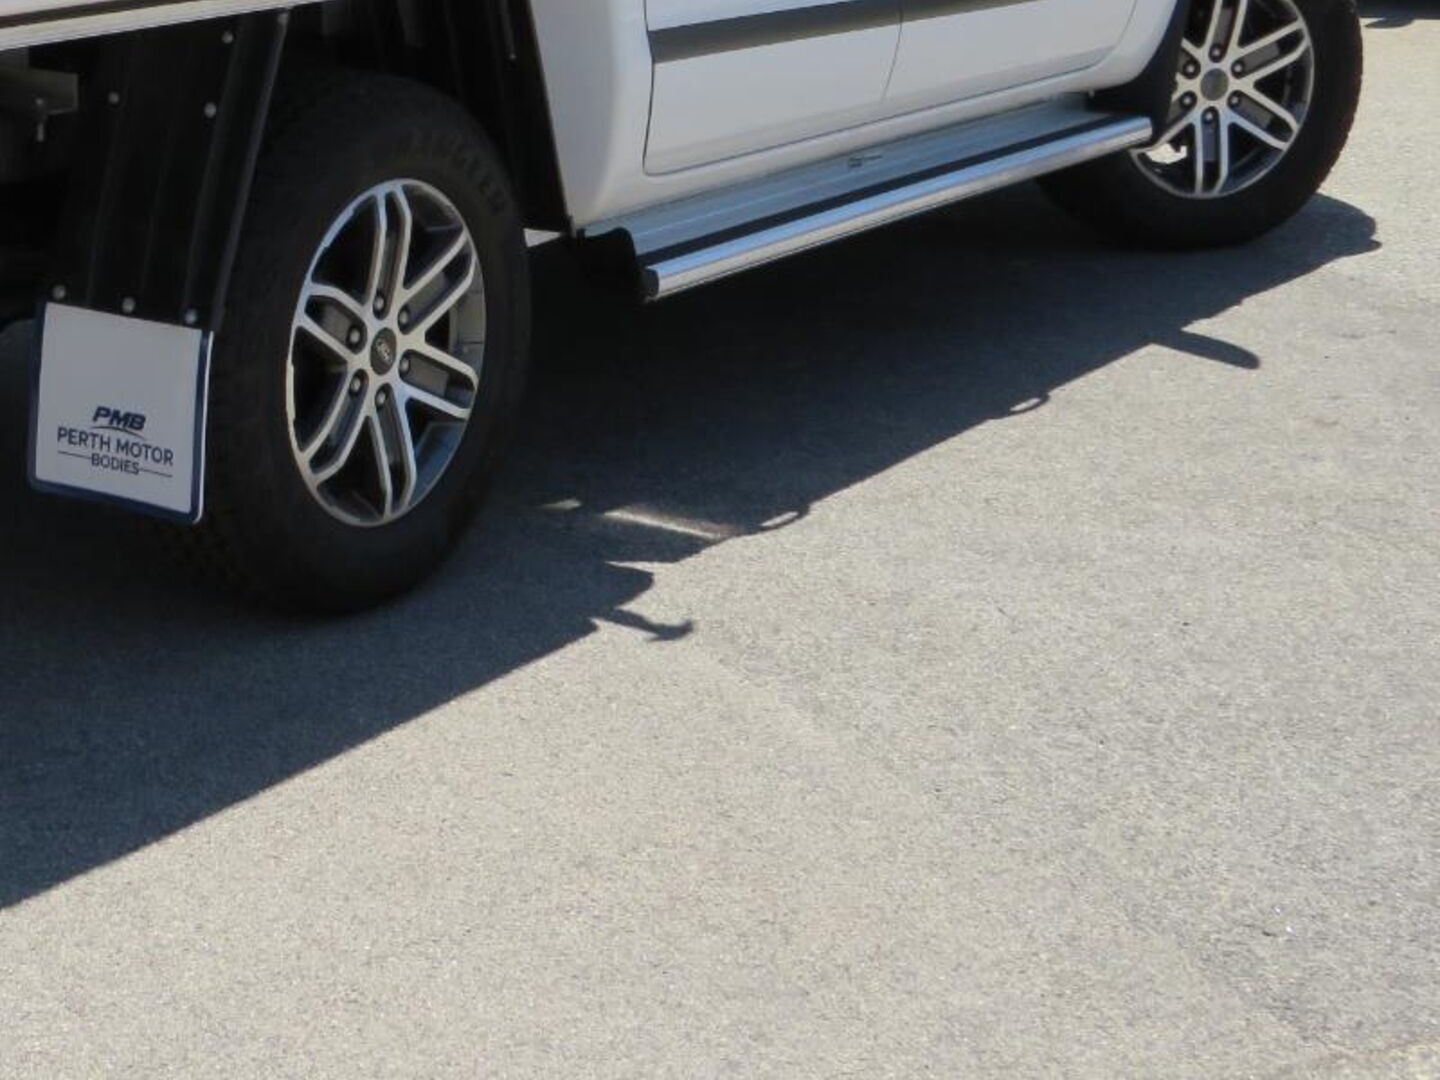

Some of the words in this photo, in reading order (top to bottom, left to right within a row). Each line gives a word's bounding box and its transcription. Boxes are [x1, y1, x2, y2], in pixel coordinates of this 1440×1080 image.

[92, 405, 147, 432] PMB
[56, 425, 112, 453] PERTH
[115, 437, 174, 467] MOTOR
[90, 452, 140, 476] BODIES
